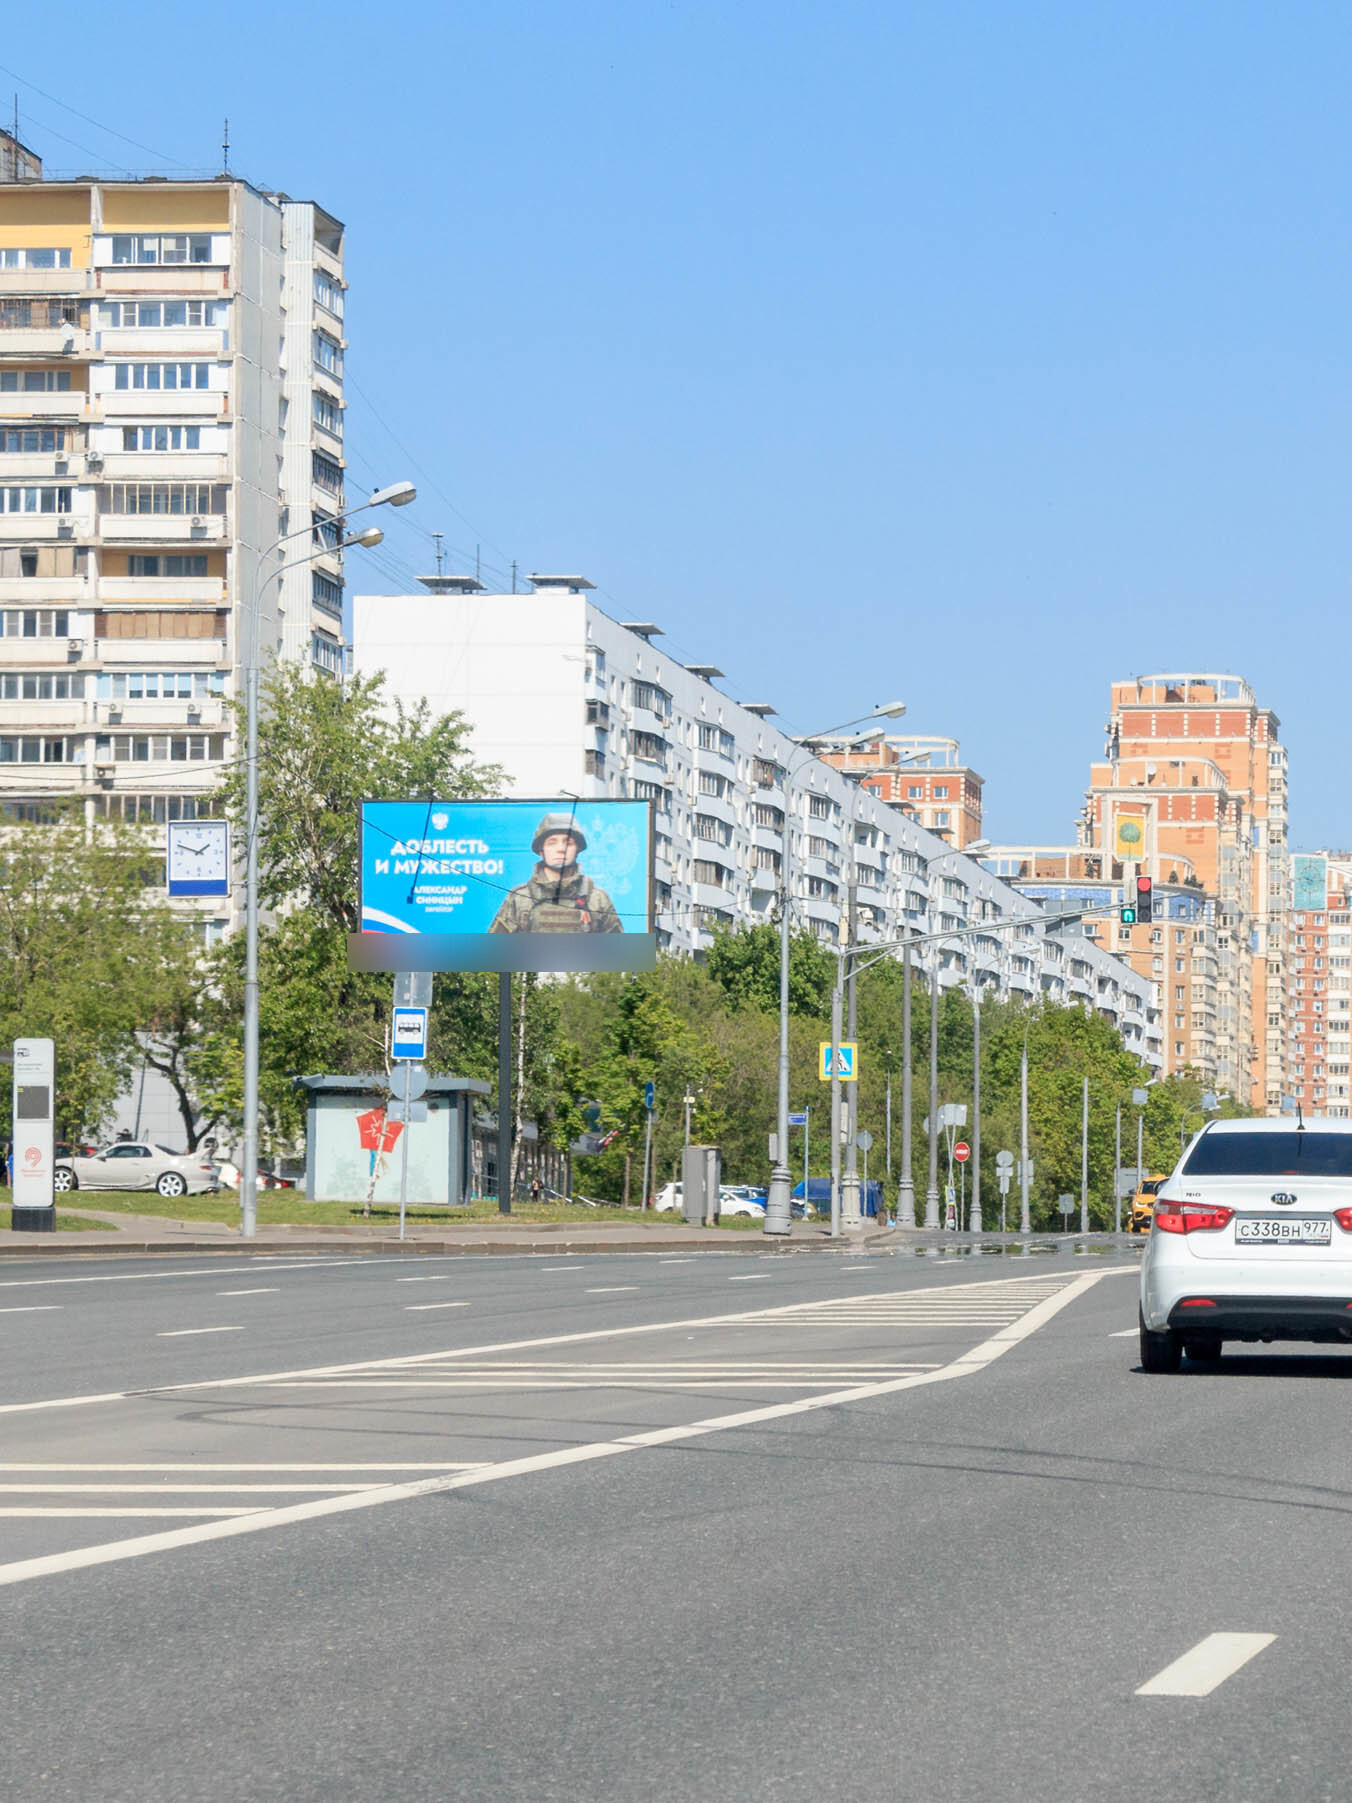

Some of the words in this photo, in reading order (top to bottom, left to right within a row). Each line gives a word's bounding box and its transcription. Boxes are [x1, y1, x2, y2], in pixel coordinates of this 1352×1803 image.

[390, 839, 489, 856] ДОБЛЕСТЬ
[375, 860, 389, 875] И
[394, 860, 504, 874] МУЖЕСТВО!
[1274, 1195, 1294, 1204] KIA
[1240, 1222, 1301, 1237] С338ВН
[1304, 1222, 1327, 1233] 977
